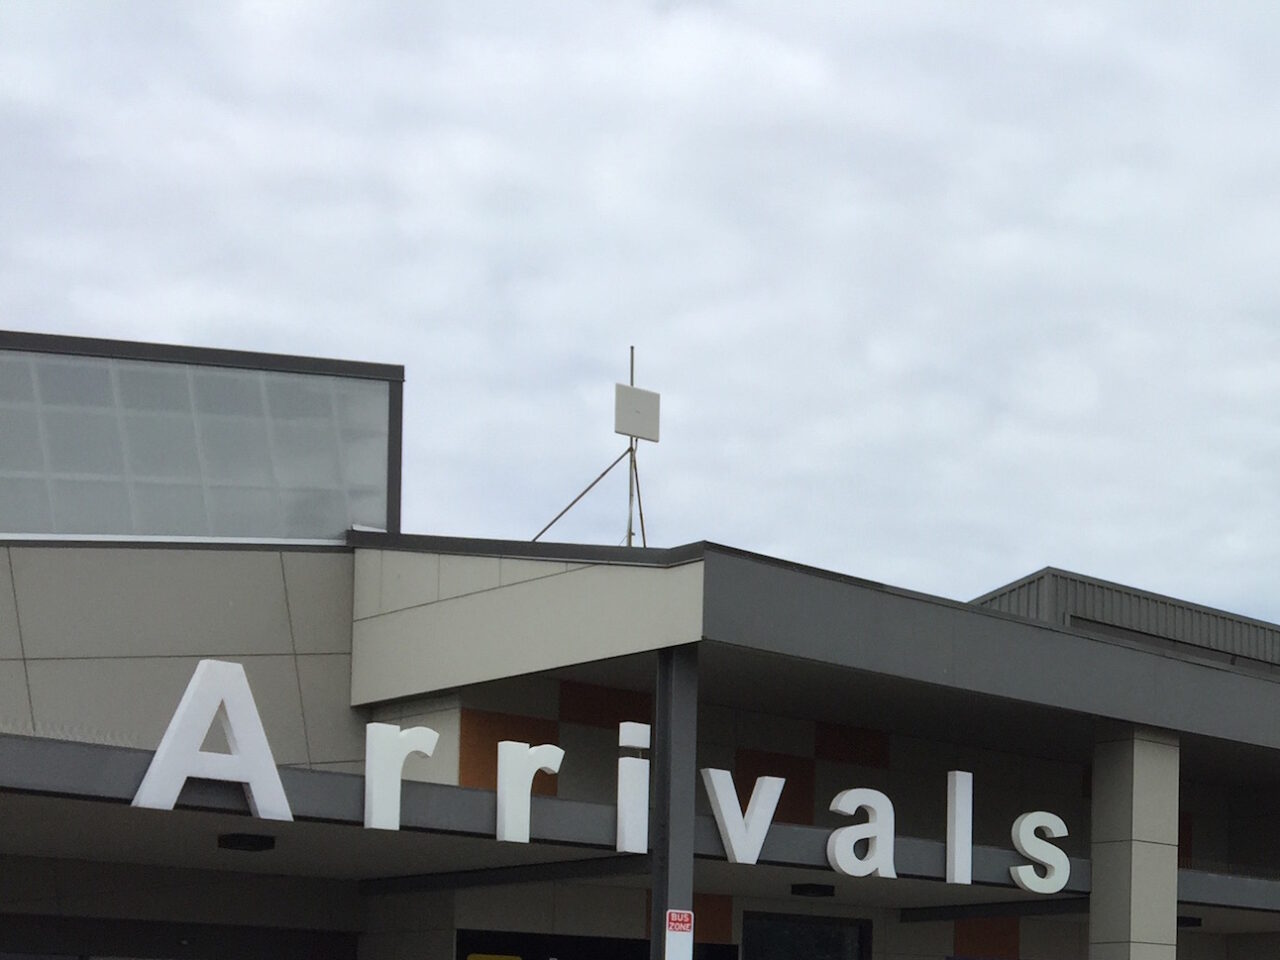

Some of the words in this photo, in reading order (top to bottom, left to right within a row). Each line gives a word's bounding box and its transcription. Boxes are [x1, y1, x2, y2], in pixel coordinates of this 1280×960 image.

[131, 659, 1071, 895] Arrivals
[671, 912, 690, 922] BUS
[669, 921, 691, 932] ZONE
